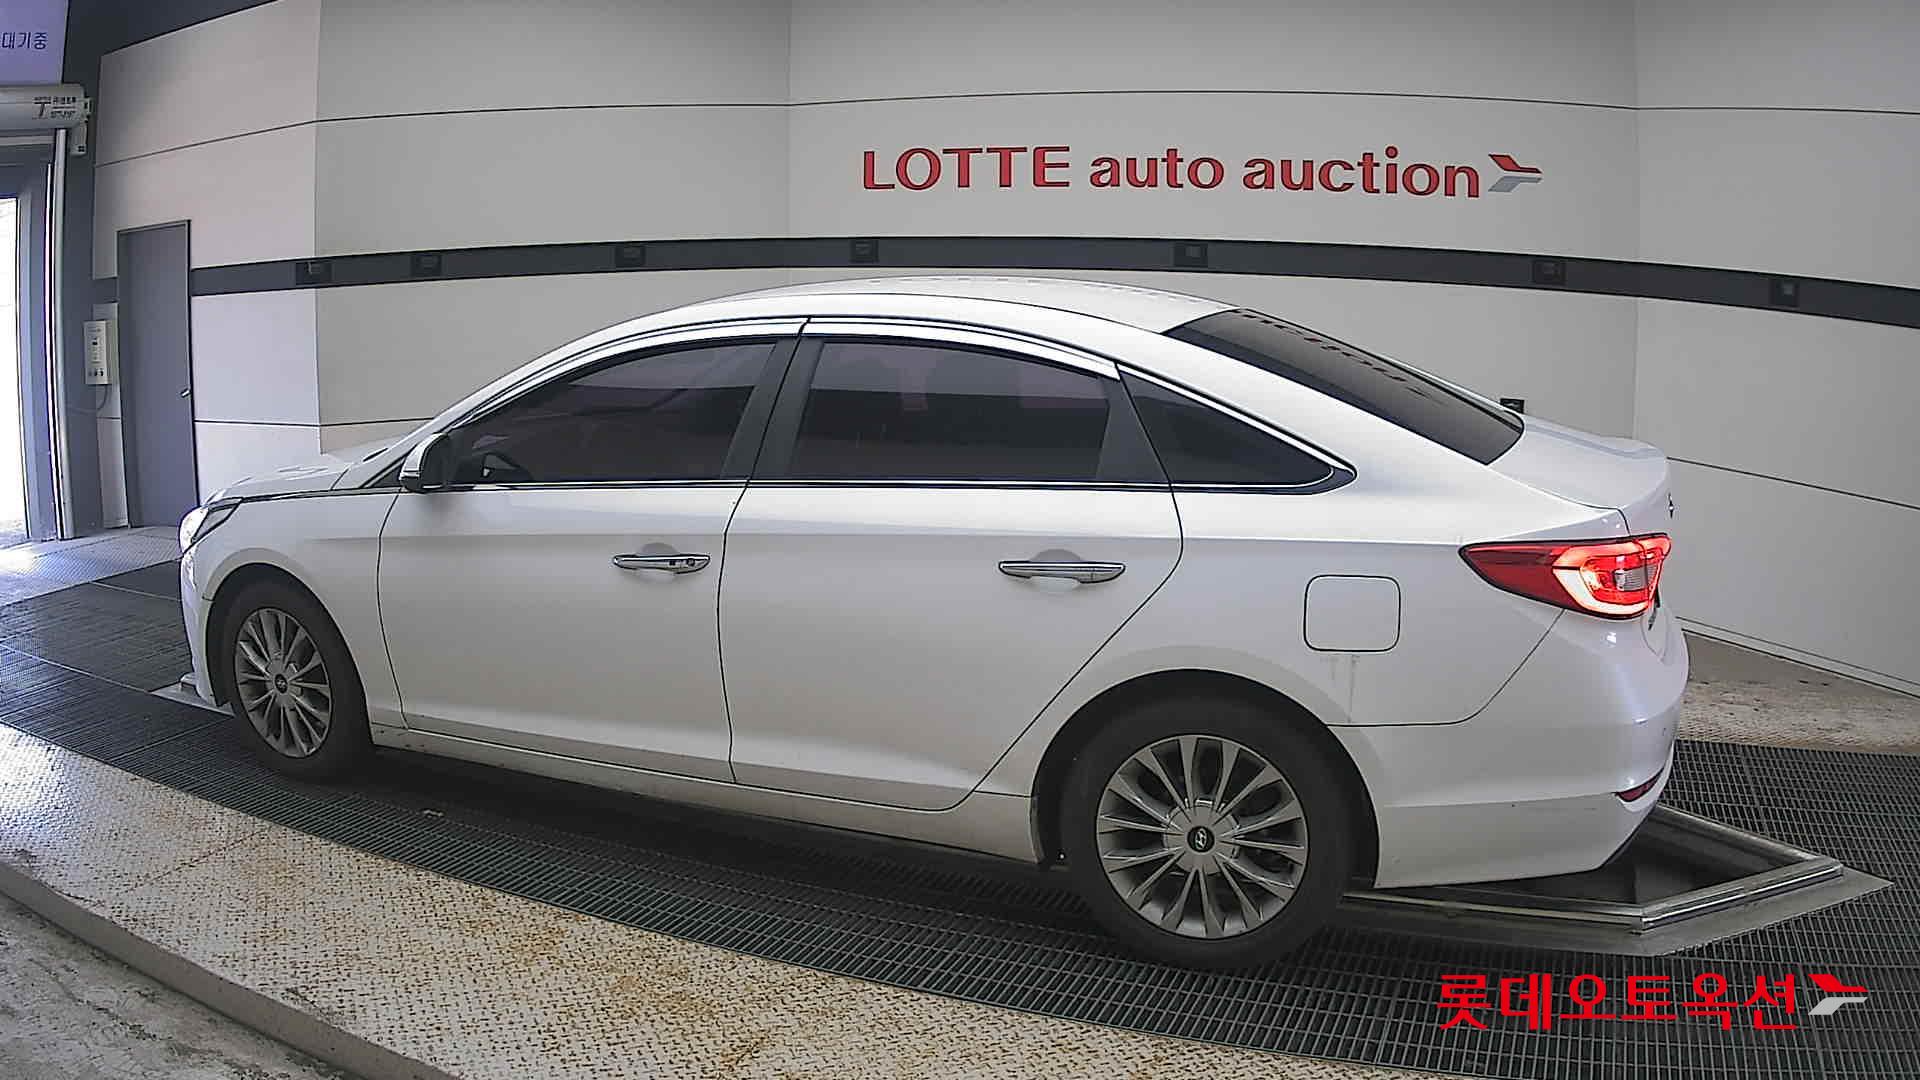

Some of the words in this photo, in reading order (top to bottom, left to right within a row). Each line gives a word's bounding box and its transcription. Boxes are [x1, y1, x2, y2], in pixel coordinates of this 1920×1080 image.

[1, 31, 48, 50] 대기중
[863, 146, 1070, 190] LOTTE
[1089, 147, 1224, 189] auto
[1242, 145, 1479, 199] auction
